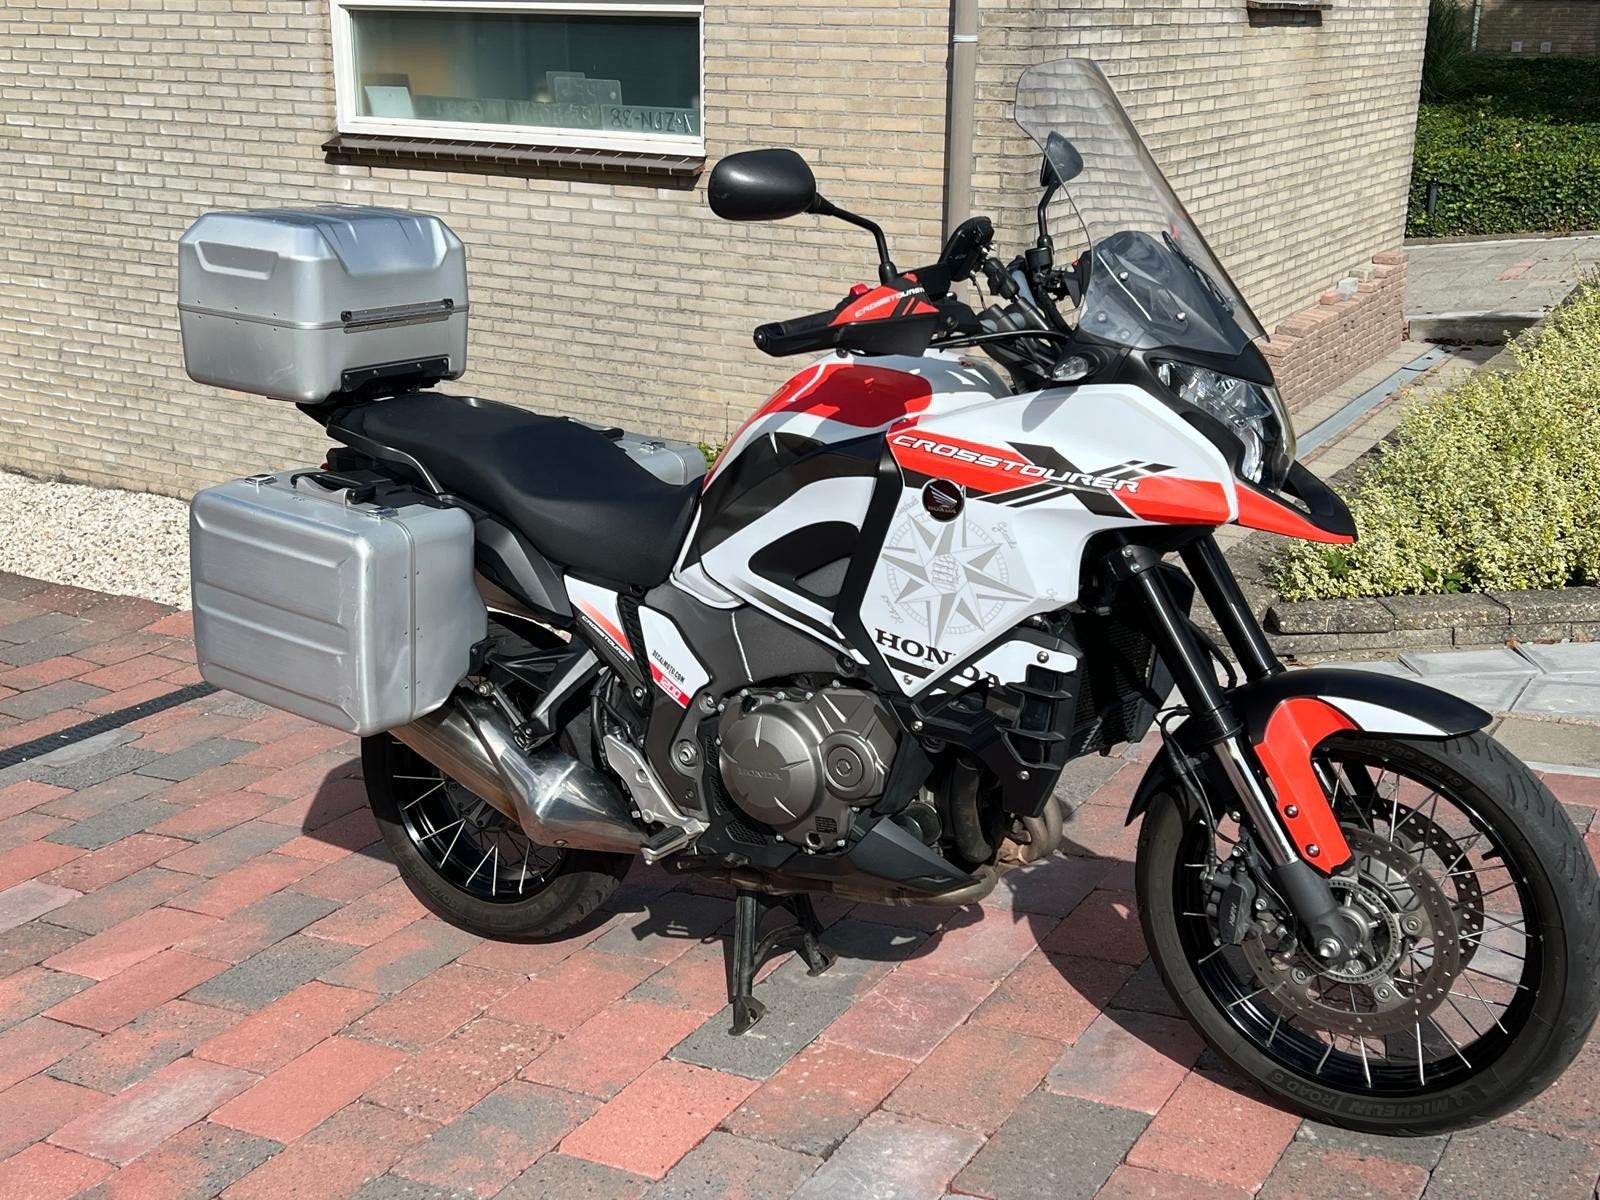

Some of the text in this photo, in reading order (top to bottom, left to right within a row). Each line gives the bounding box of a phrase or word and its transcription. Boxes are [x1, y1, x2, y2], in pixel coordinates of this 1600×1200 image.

[891, 434, 1140, 493] CROSSTOURER
[581, 615, 630, 662] CROSSTOURER
[1288, 1080, 1333, 1107] ROAD
[1349, 1097, 1450, 1118] MICHELIN
